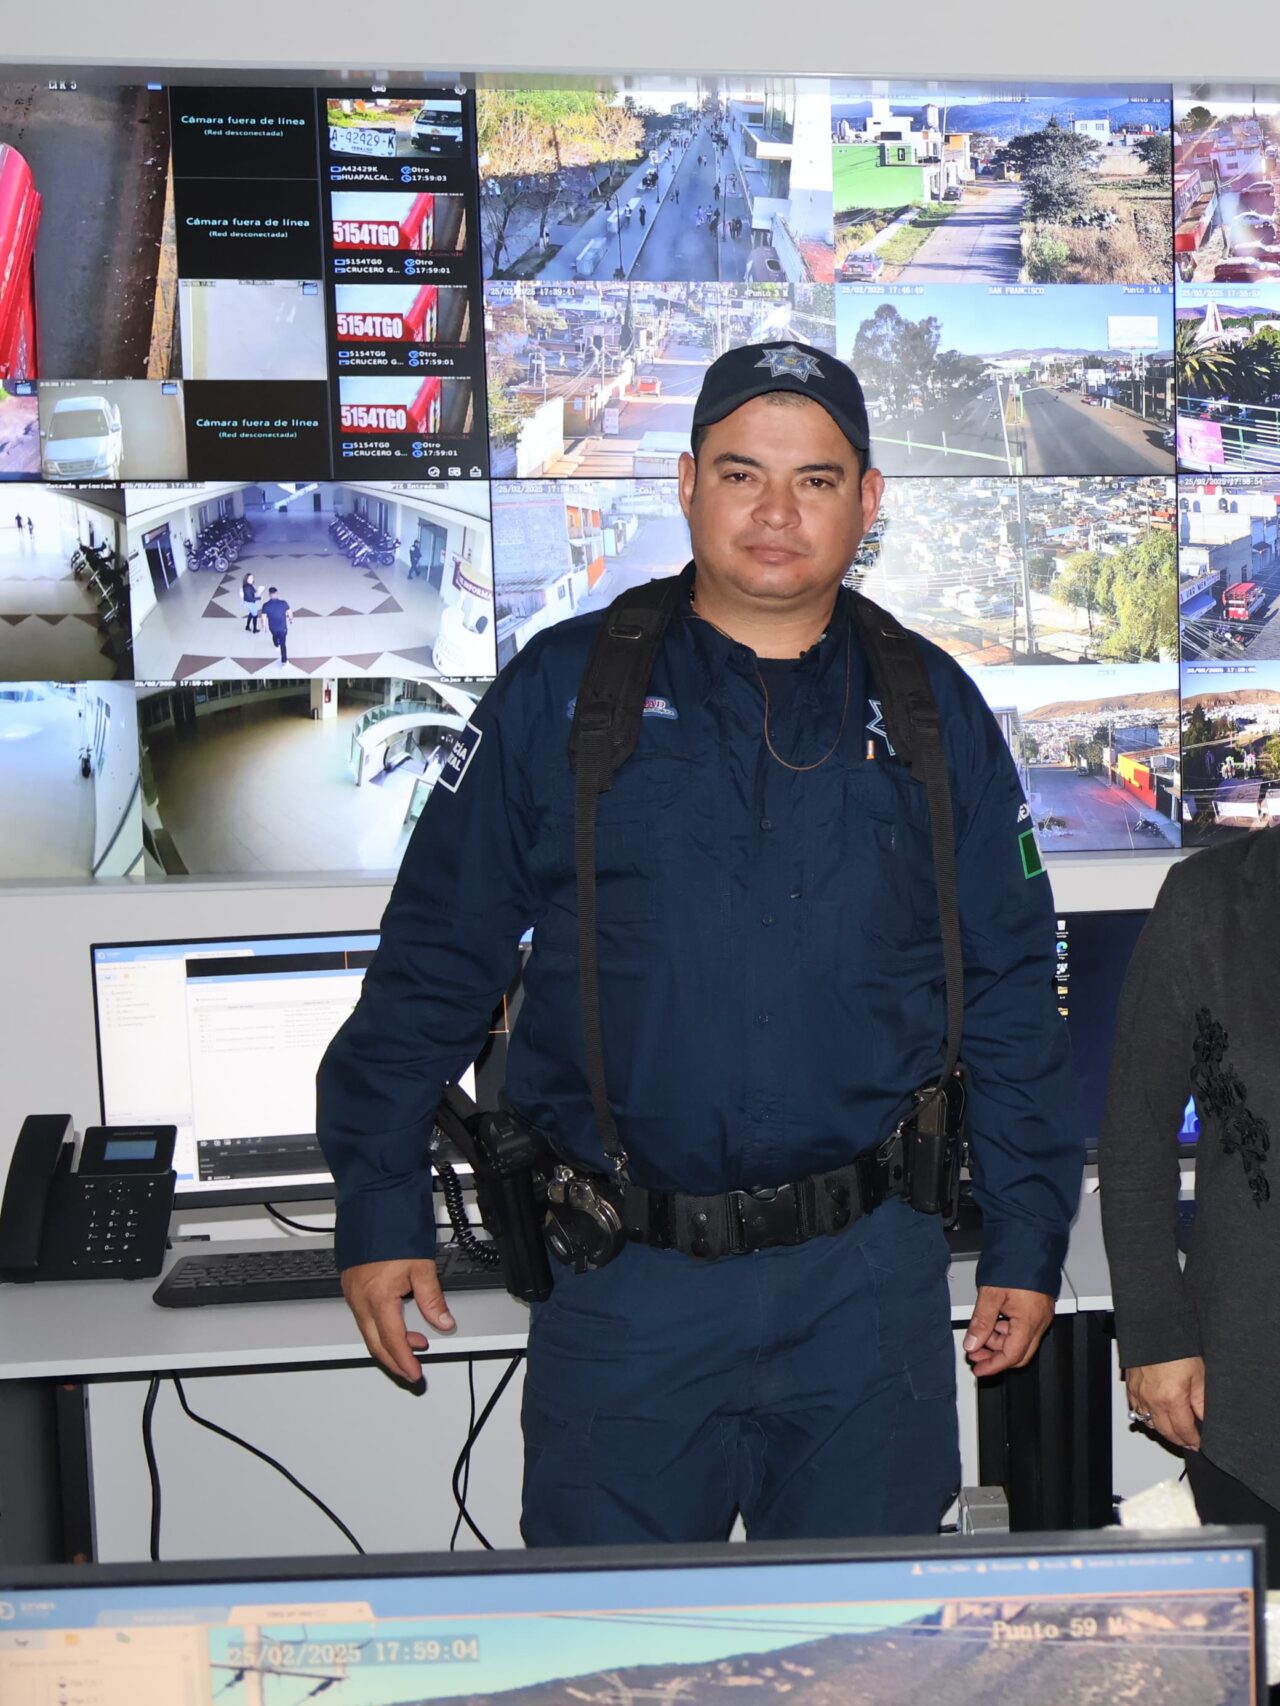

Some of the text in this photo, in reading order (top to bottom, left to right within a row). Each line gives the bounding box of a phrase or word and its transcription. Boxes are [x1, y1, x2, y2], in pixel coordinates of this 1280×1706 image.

[181, 116, 306, 126] Cámara fuera de línea
[186, 218, 310, 227] Cámara fuera de línea
[196, 419, 319, 428] Cámara fuera de línea
[992, 1620, 1060, 1641] Punto
[1070, 1616, 1098, 1638] 59
[228, 1640, 479, 1666] 25/02/2025 17:59:04
